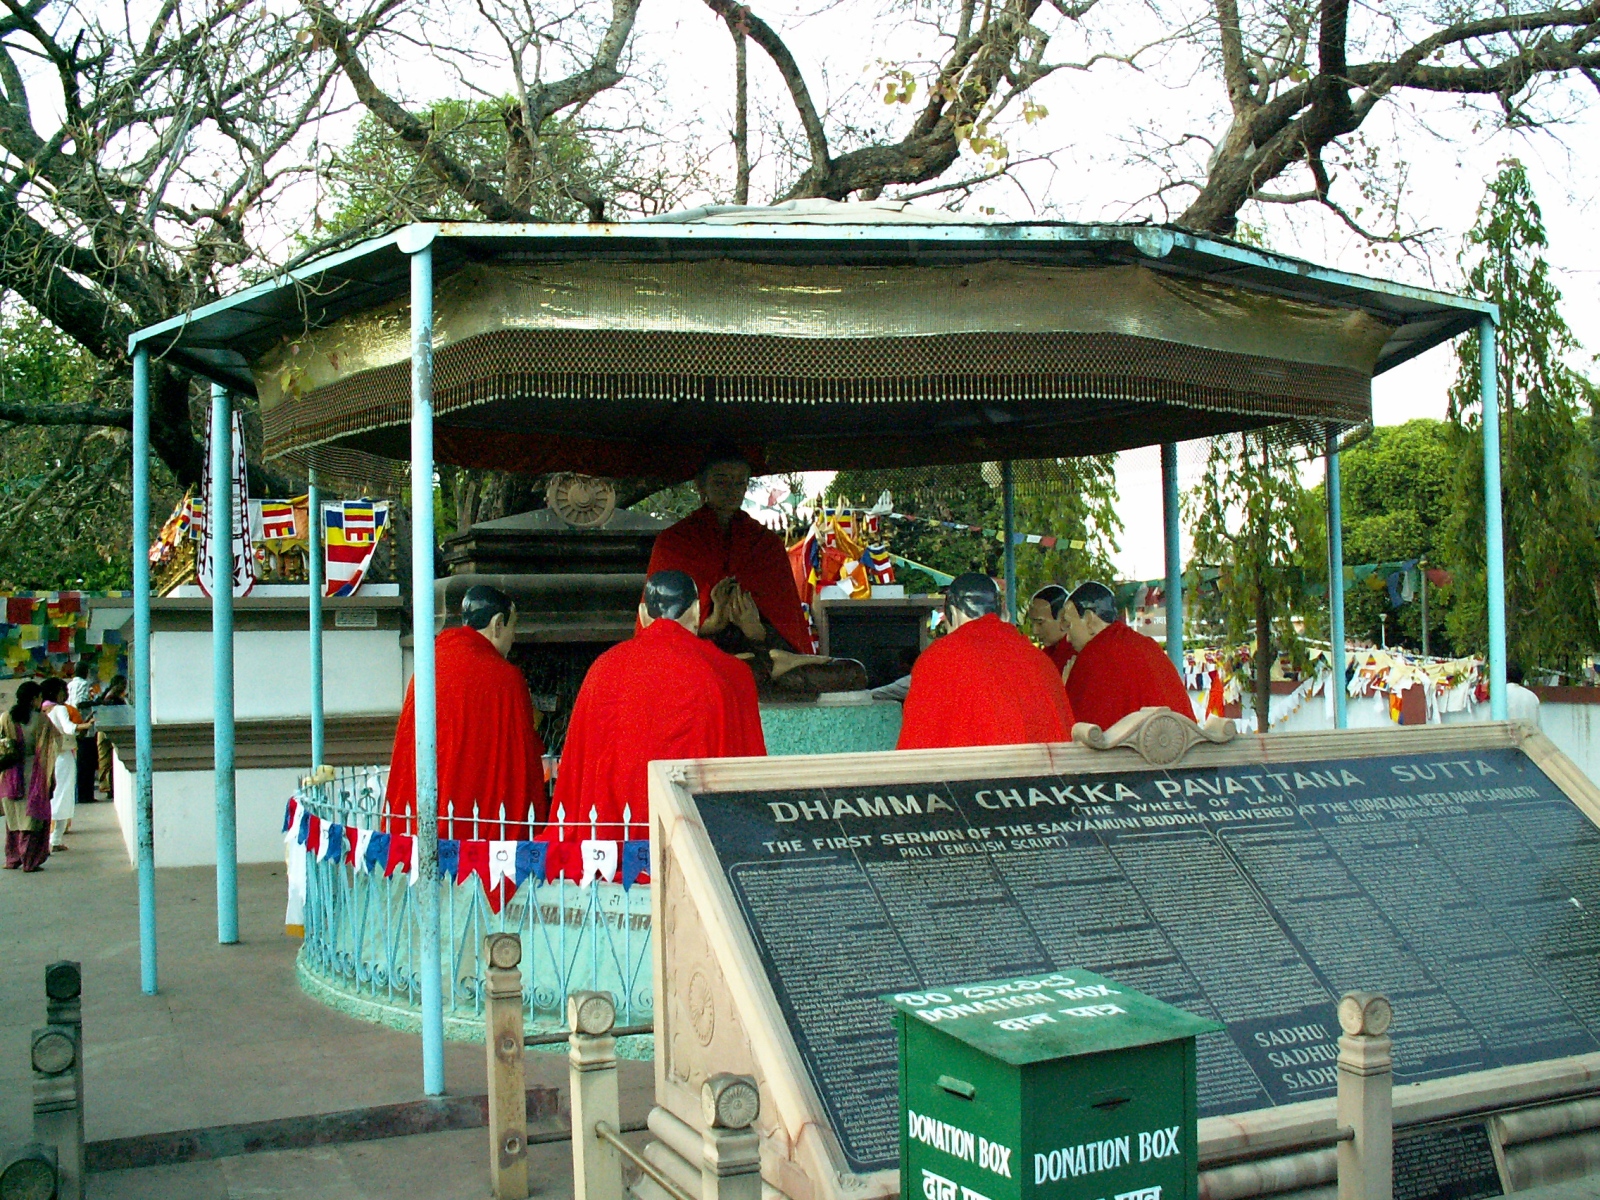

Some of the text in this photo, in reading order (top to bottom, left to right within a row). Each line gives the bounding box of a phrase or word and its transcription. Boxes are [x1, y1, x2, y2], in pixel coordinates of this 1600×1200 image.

[767, 760, 1500, 822] DHAMMA CHAKKA PAVATTANA SUTTA
[1128, 801, 1197, 813] WHEEL
[1209, 798, 1231, 807] OF
[763, 840, 806, 853] THE
[812, 835, 872, 850] FIRST
[880, 829, 964, 846] SERMON
[967, 827, 992, 840] OF
[1000, 823, 1037, 837] THE
[1037, 817, 1140, 835] SAKYAMUNI
[1140, 811, 1209, 827] BUDDHA
[1209, 807, 1294, 822] DELIVERED
[1299, 803, 1317, 816] AT
[1319, 801, 1351, 814] THE
[1334, 805, 1469, 825] ENGLISH TRANSLATION
[899, 835, 1069, 859] PALI (ENGLISH SCRIPT)
[914, 993, 1056, 1022] DONATION
[1055, 984, 1122, 1000] BOX
[993, 1012, 1057, 1031] दान
[1282, 1066, 1338, 1089] SADH
[908, 1110, 1012, 1179] DONATION BOX
[1034, 1126, 1181, 1186] DONATION BOX
